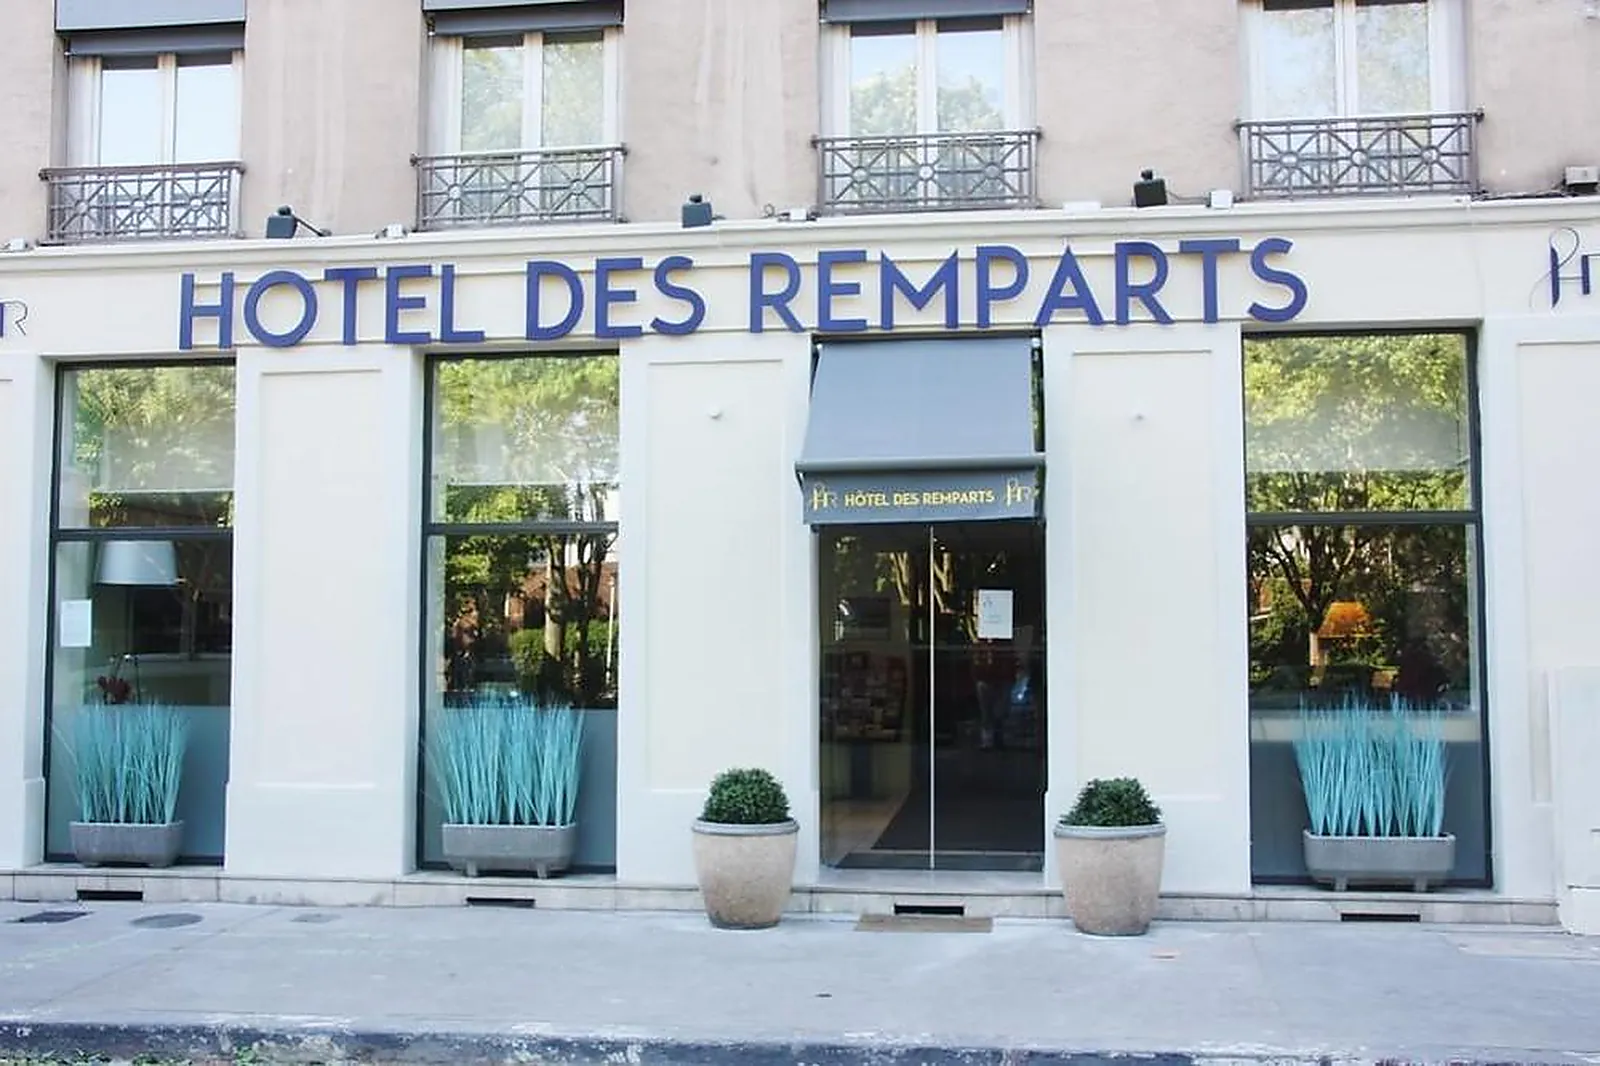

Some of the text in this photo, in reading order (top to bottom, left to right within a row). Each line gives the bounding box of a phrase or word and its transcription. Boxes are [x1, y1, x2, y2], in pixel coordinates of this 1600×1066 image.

[180, 238, 1307, 350] HOTEL DES REMPARTS
[893, 491, 919, 506] DES
[922, 489, 995, 505] REMPARTS
